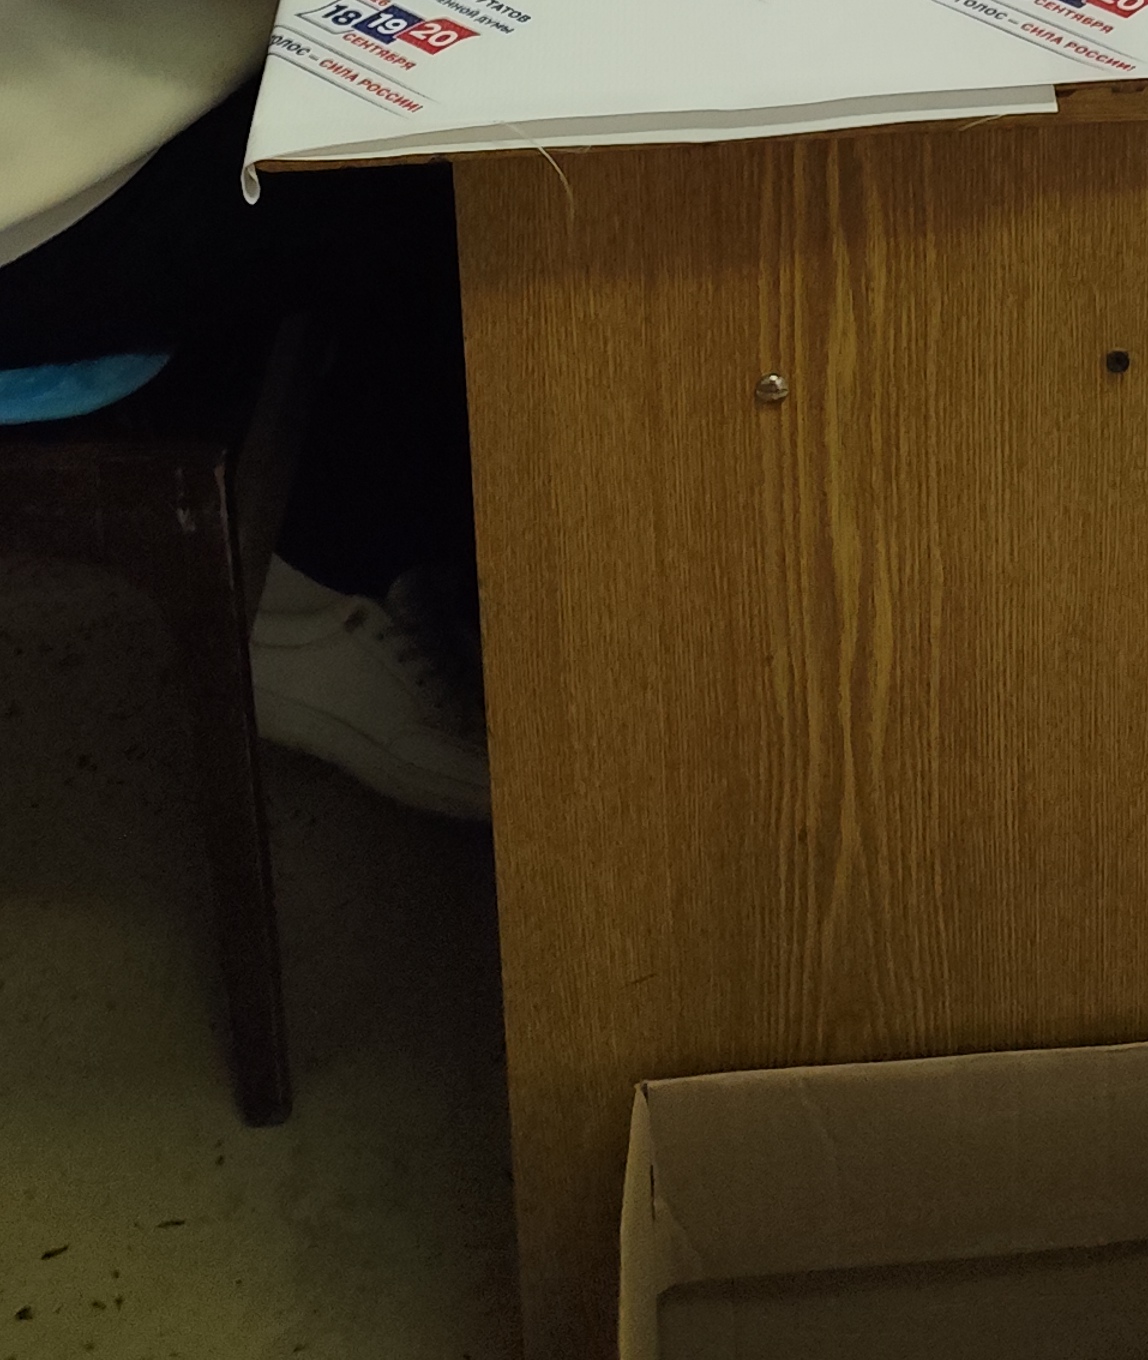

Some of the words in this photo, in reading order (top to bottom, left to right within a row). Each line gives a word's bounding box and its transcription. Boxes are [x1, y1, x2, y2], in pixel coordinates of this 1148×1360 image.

[321, 3, 362, 27] 18
[370, 11, 408, 36] 19
[416, 22, 457, 48] 20
[475, 14, 515, 34] ДУМЫ
[342, 32, 417, 71] СЕНТЯБРЯ
[1020, 21, 1063, 46] СИЛА
[1063, 39, 1137, 73] РОССИИ!
[270, 34, 311, 56] ОЛОС
[319, 57, 358, 83] СИЛА
[360, 78, 424, 114] РОССИИ!
